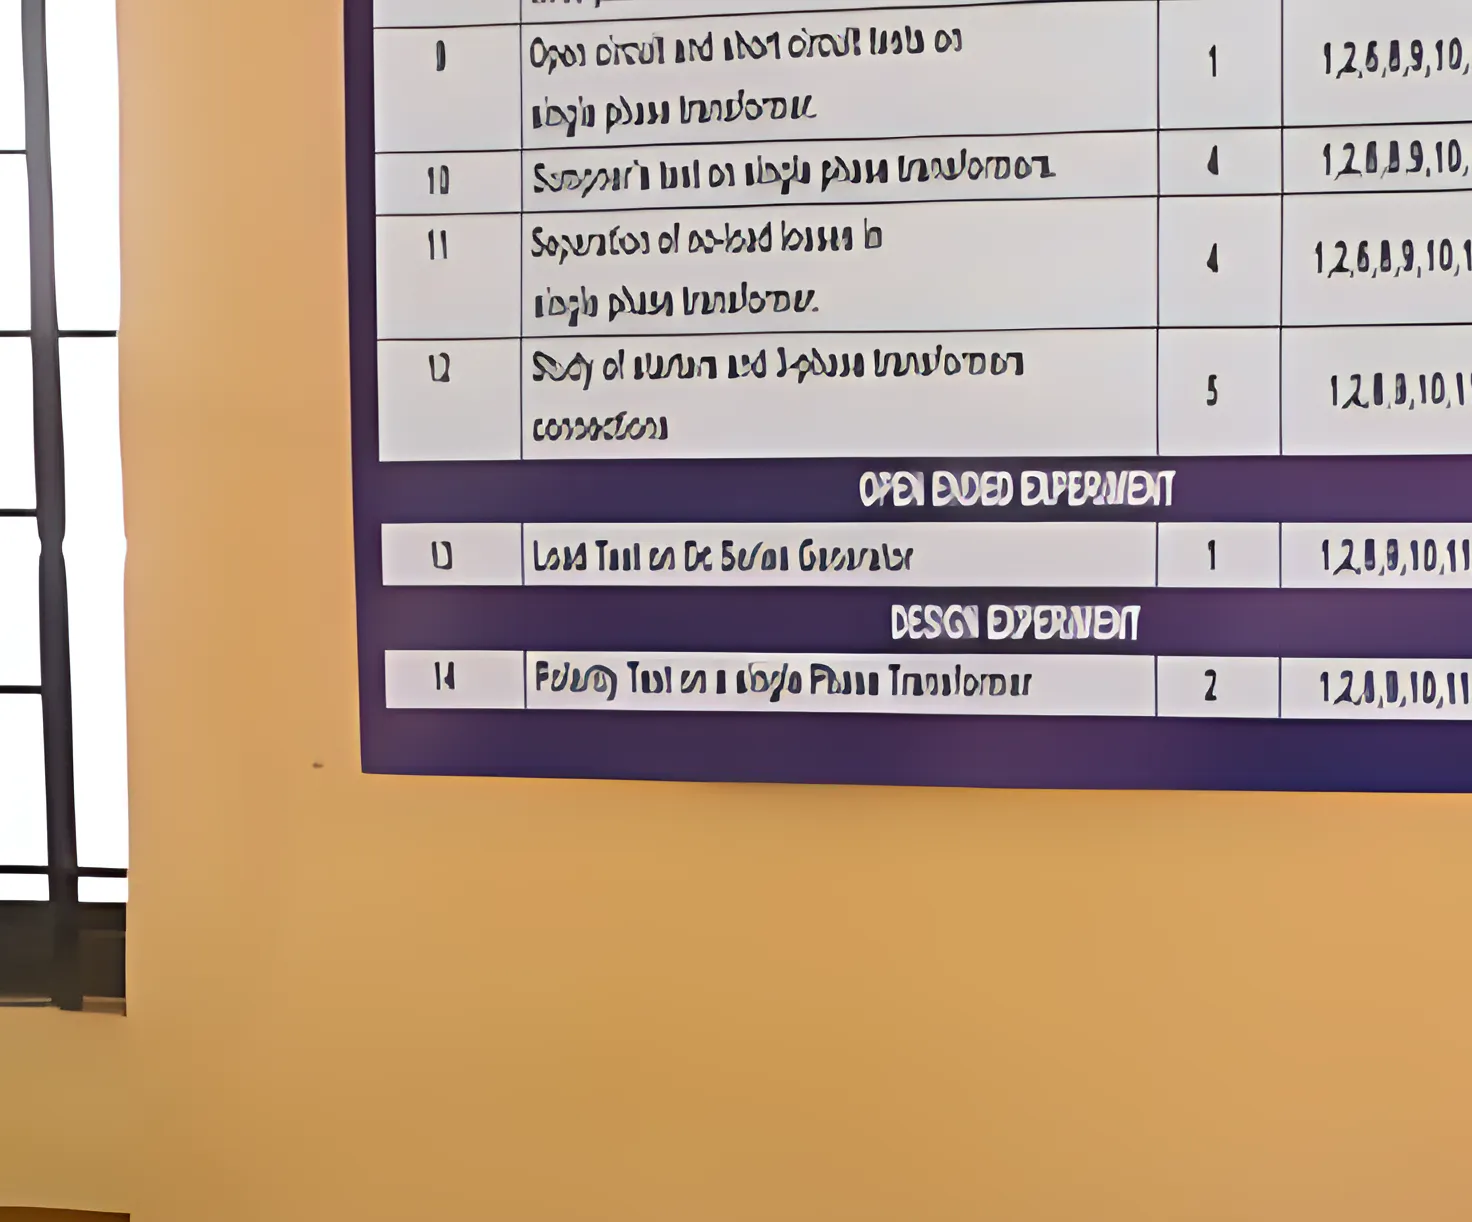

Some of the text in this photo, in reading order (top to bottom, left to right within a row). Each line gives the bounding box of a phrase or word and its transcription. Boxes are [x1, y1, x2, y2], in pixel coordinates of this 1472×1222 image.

[1208, 44, 1217, 78] 1
[1206, 144, 1219, 176] 4
[427, 164, 450, 195] 10
[427, 228, 448, 261] 11
[1206, 242, 1219, 273] 4
[1206, 374, 1218, 407] 5
[859, 470, 925, 507] OPEN
[931, 470, 1014, 507] ENDED
[1207, 539, 1216, 571] 1
[891, 604, 980, 640] DESIGN
[1204, 668, 1218, 702] 2
